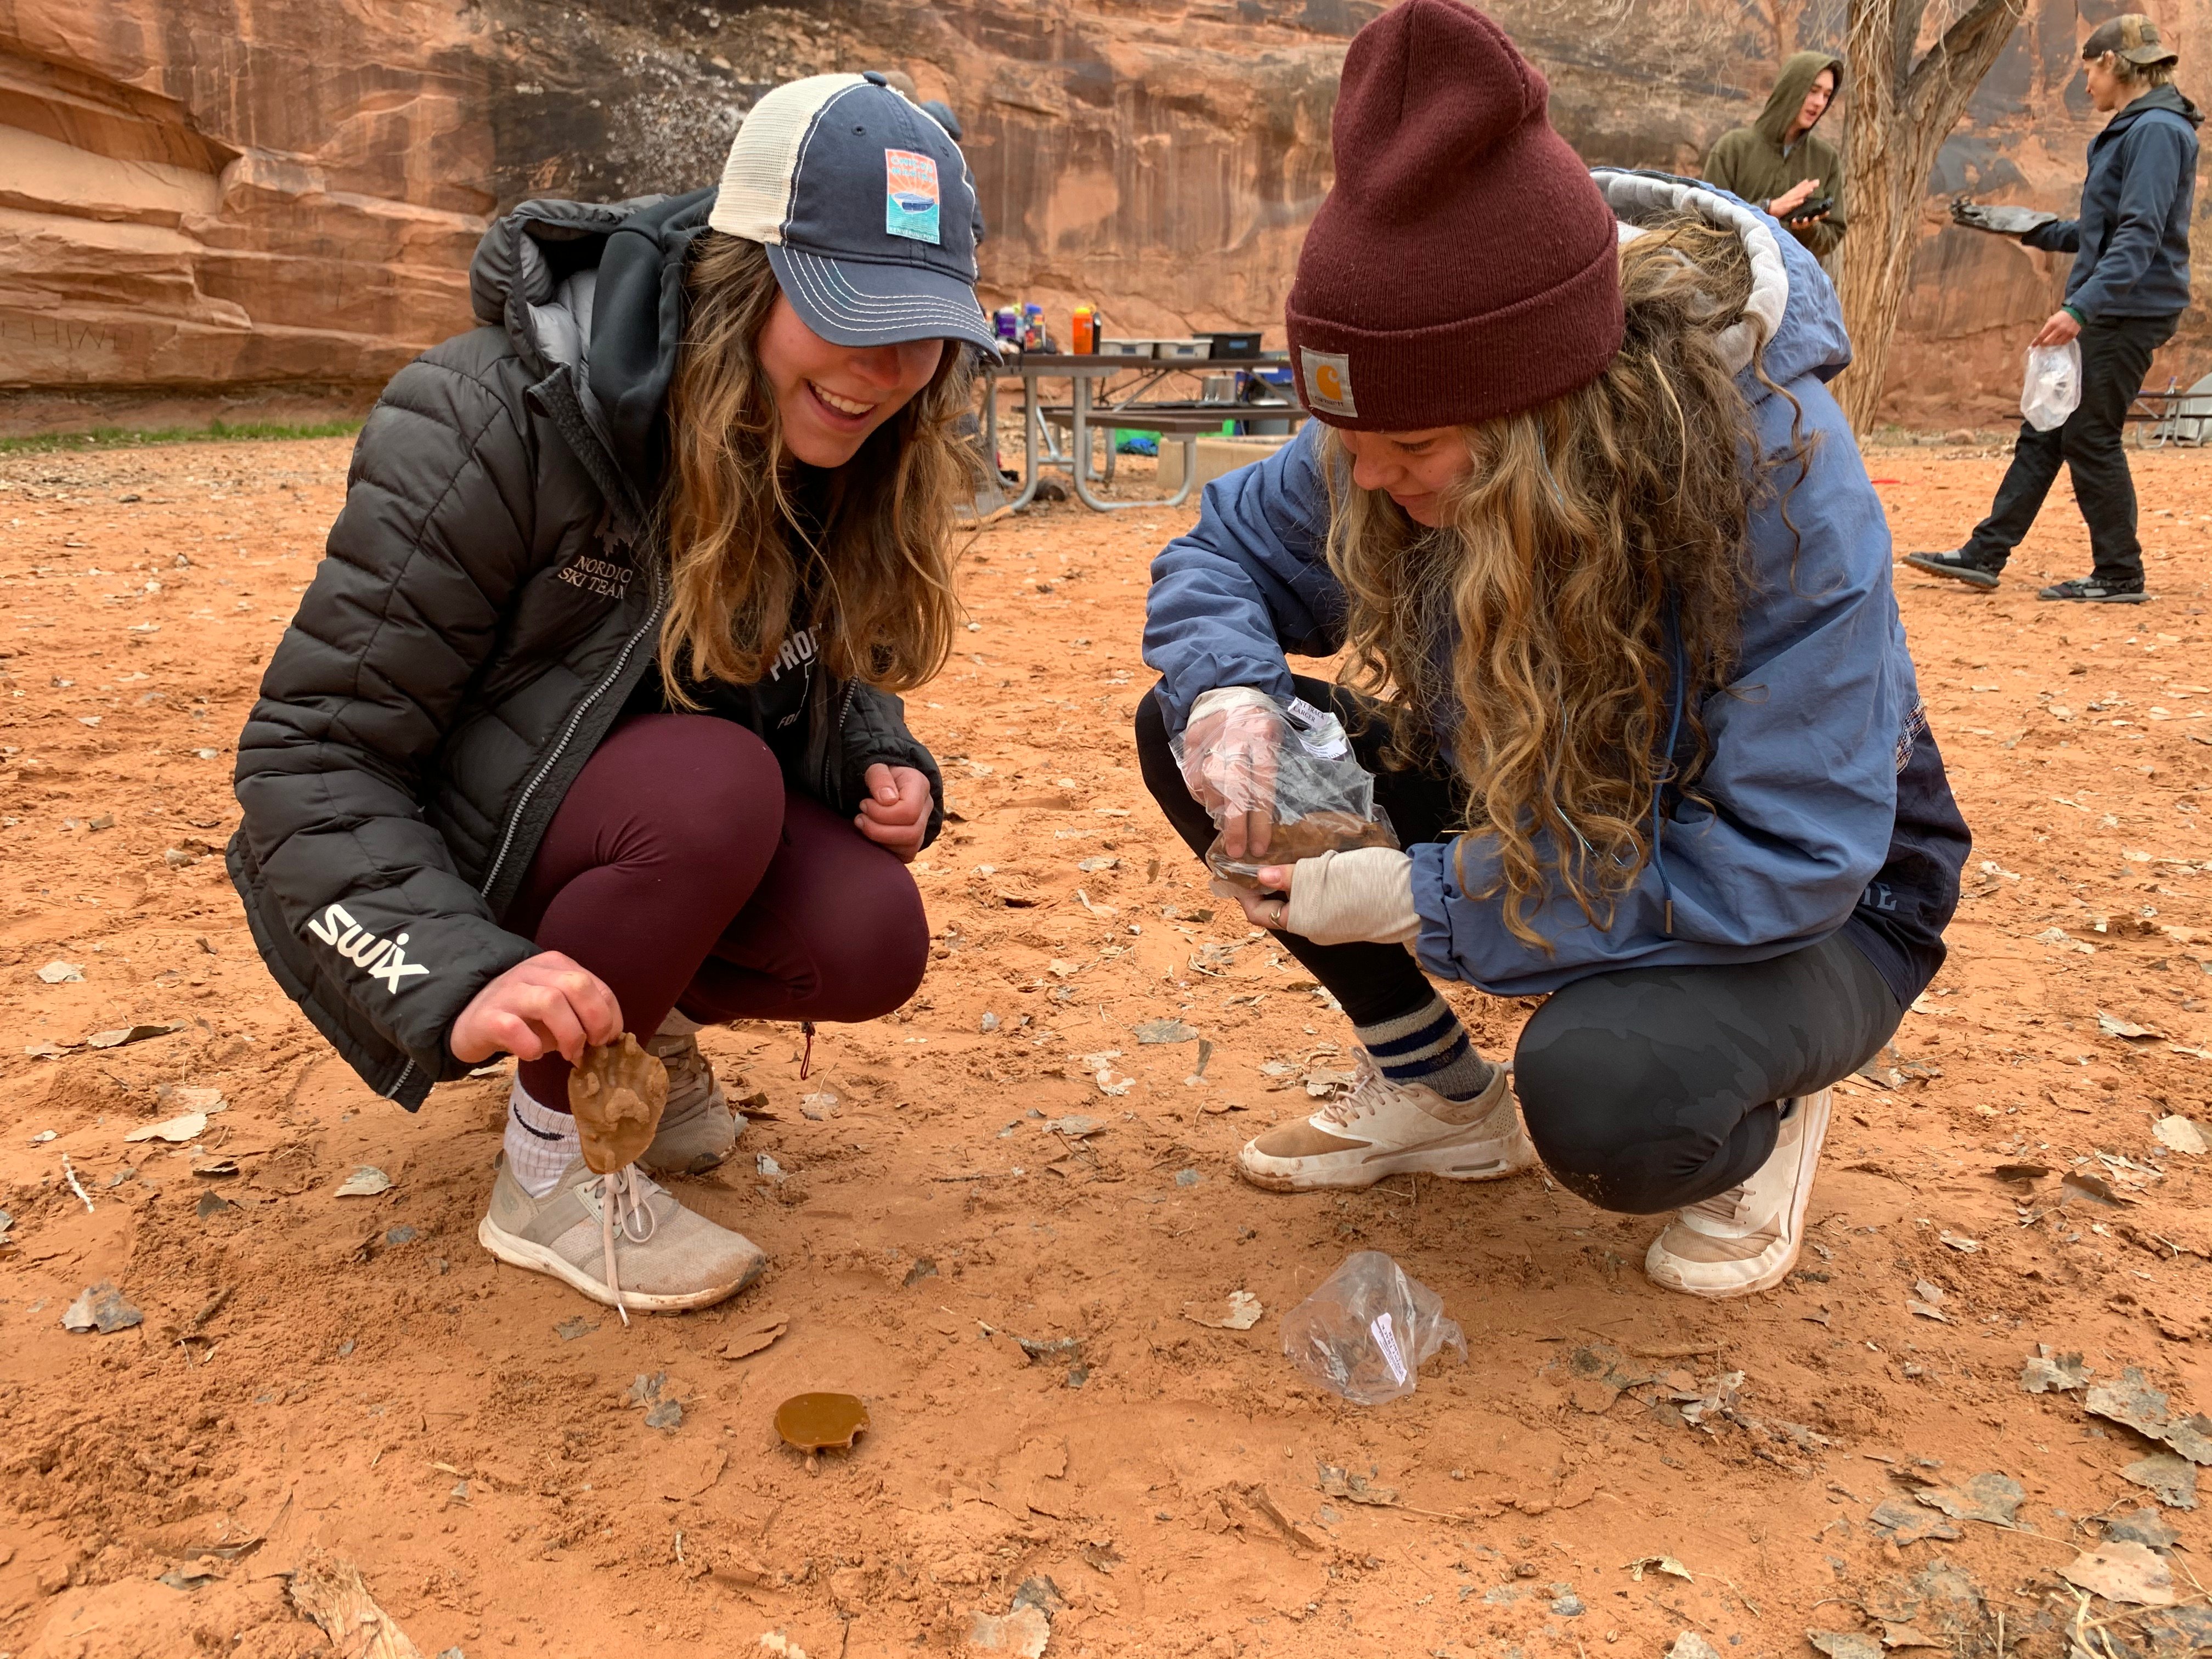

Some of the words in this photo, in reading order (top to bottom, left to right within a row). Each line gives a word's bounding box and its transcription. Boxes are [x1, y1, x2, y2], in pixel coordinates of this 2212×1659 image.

[574, 555, 633, 583] NORDIC
[558, 567, 589, 588] SKI
[588, 577, 627, 600] TEAM
[1293, 706, 1316, 723] LARGER
[1308, 704, 1327, 720] TRACK
